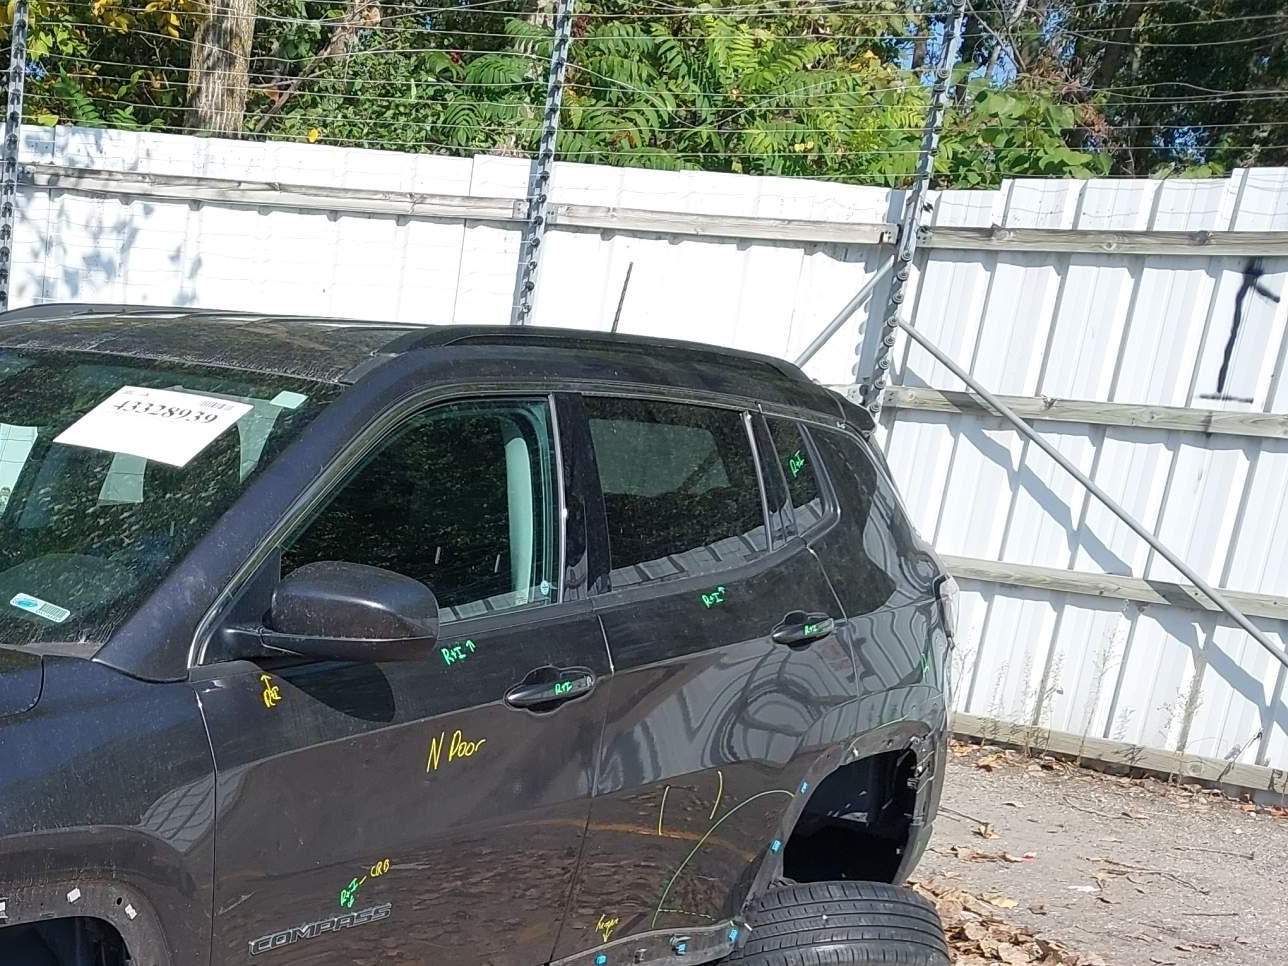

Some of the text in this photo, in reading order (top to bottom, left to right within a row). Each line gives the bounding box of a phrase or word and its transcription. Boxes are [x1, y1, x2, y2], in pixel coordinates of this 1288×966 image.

[113, 400, 218, 424] 43328939
[426, 730, 486, 773] N Door
[248, 902, 392, 956] COMPASS
